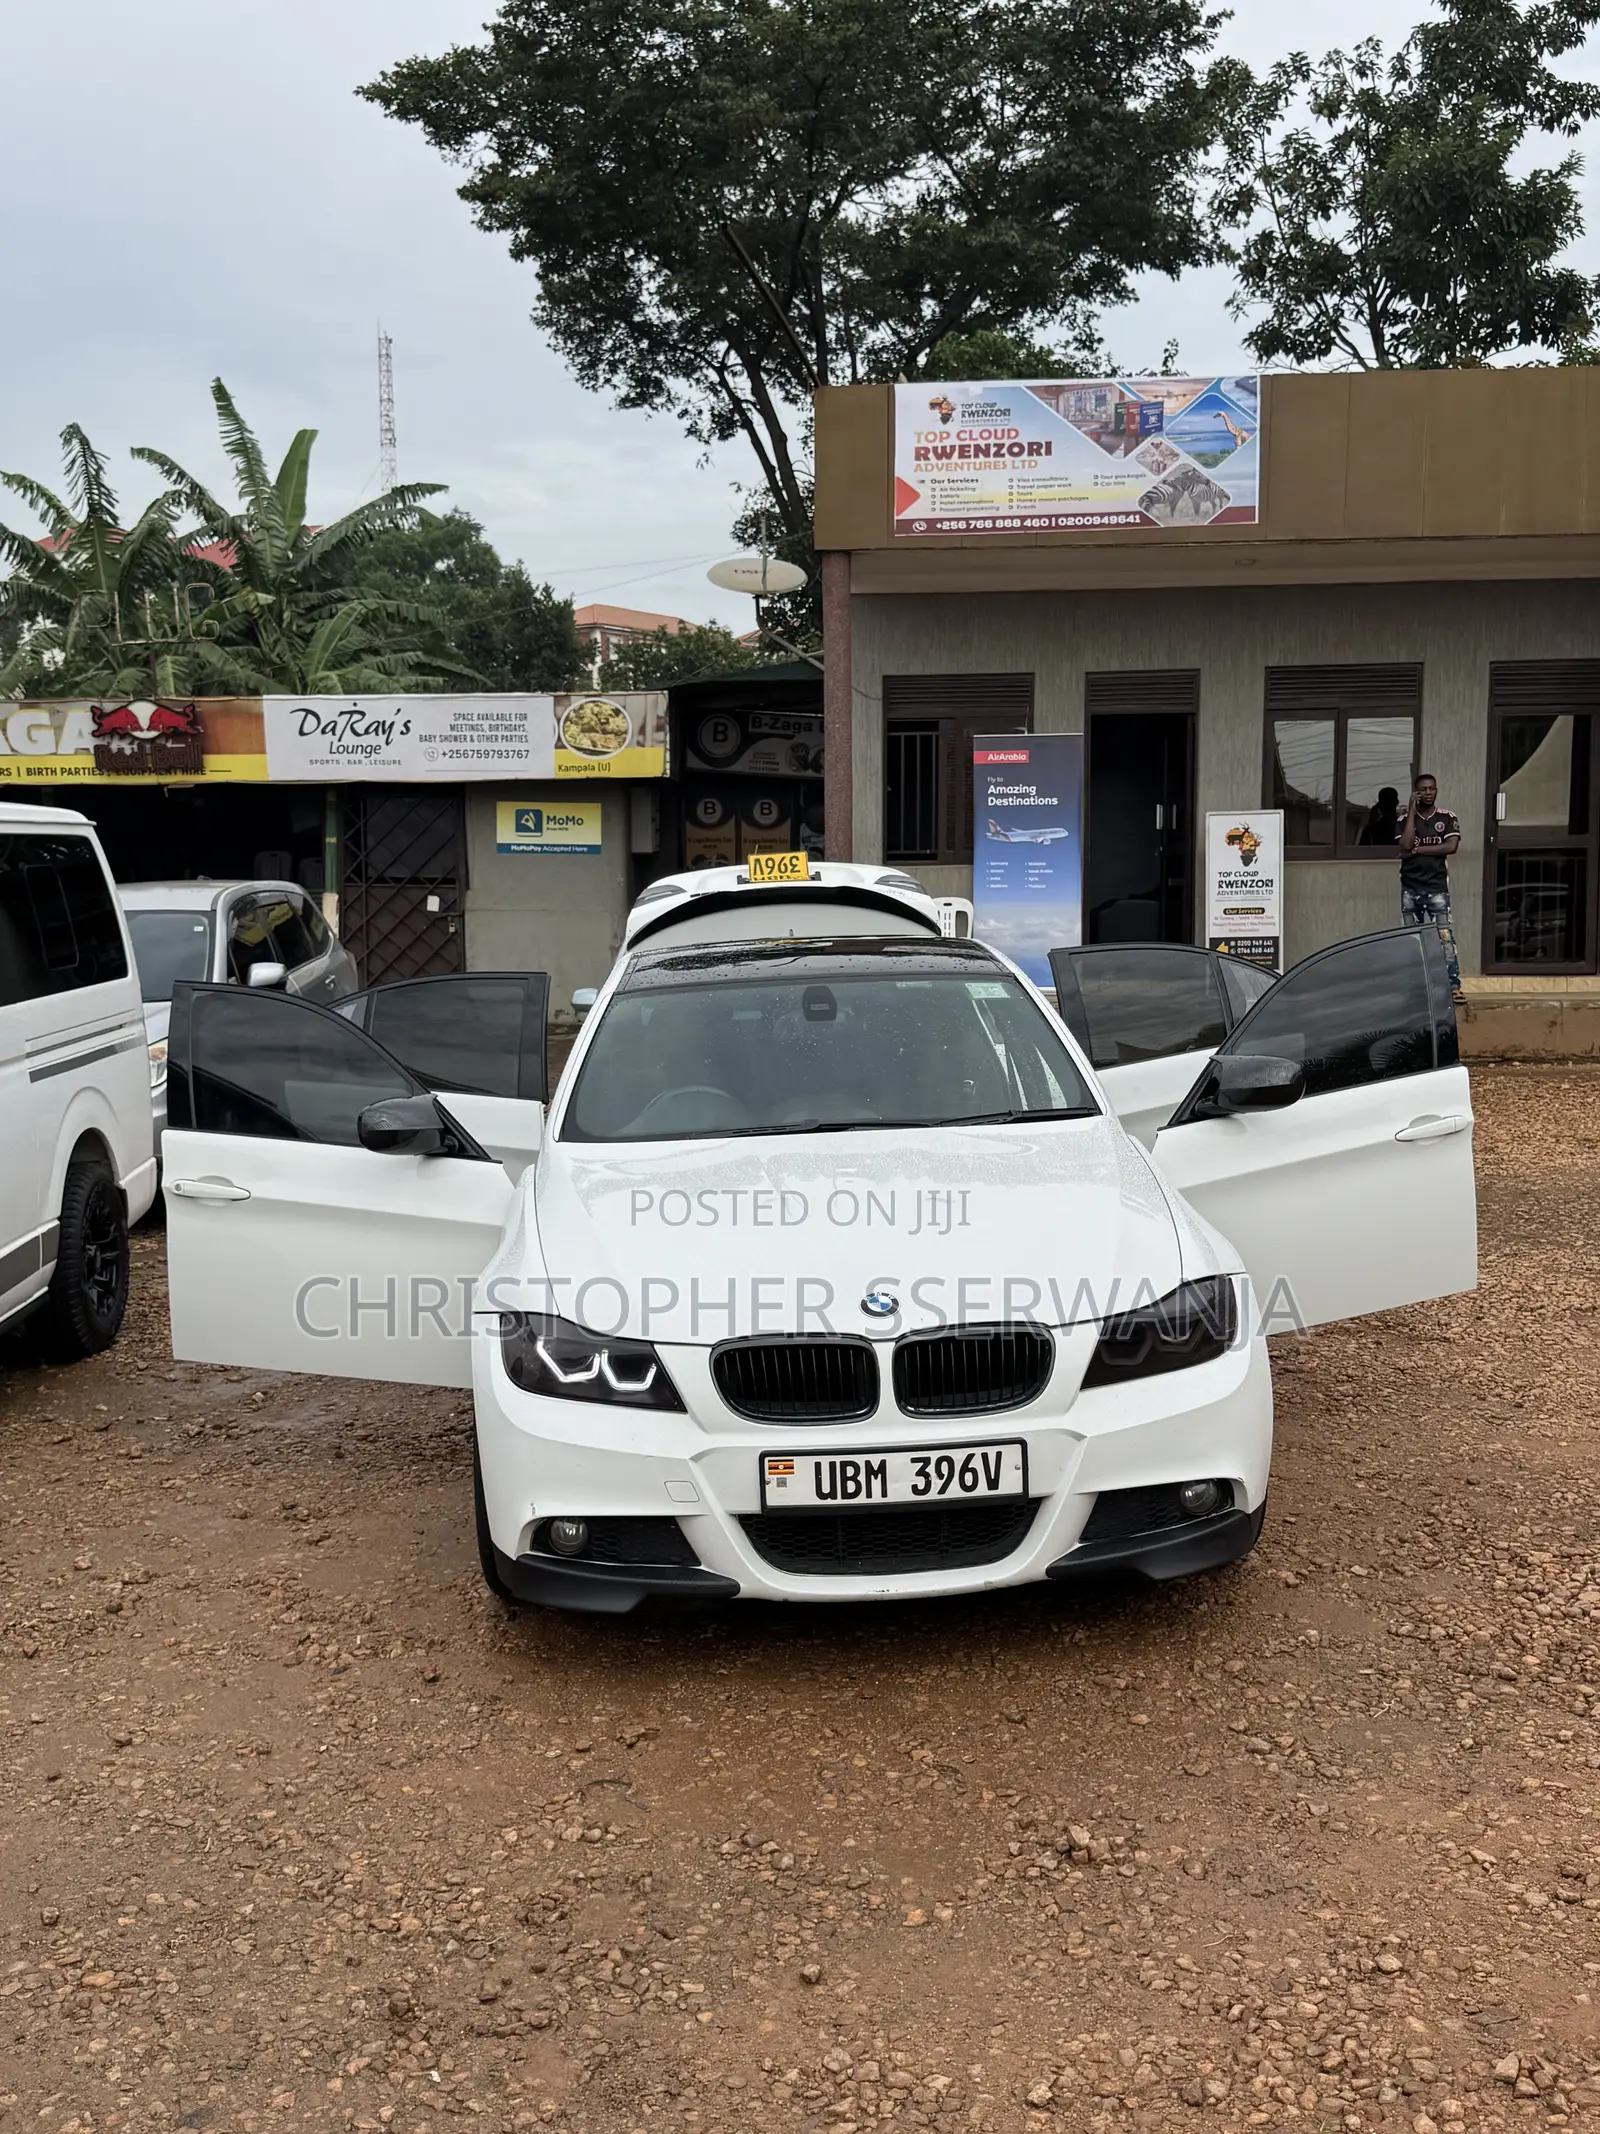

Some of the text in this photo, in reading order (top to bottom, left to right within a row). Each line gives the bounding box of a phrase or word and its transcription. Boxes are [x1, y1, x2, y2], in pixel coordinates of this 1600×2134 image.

[961, 408, 1011, 418] RWENZORI
[914, 428, 1019, 443] TOP CLOUD
[914, 441, 1052, 461] RWENZORI
[913, 459, 1038, 472] ADVENTURES LTD
[936, 520, 967, 530] +256
[969, 519, 993, 529] 766
[995, 518, 1021, 529] 868
[1023, 518, 1049, 528] 460
[1057, 515, 1141, 527] 0200949641
[453, 713, 528, 722] SPACE AVAILABLE FOR
[449, 723, 487, 733] MEETINGS,
[751, 716, 813, 733] B-Zaga
[0, 708, 95, 755] GA
[712, 721, 728, 743] B
[418, 734, 529, 743] BABY SHOWER & OTHER PARTIES
[329, 741, 382, 758] Lounge
[441, 749, 530, 759] +256759793767
[987, 752, 1027, 761] AirArabia
[26, 767, 58, 777] BIRTH
[60, 767, 105, 777] PARTIES
[557, 763, 596, 773] Kampala
[987, 776, 996, 784] Fly
[987, 784, 1037, 796] Amazing
[987, 795, 1059, 806] Destinations
[703, 801, 717, 815] B
[759, 801, 773, 816] B
[547, 815, 584, 826] MoMo
[510, 844, 542, 852] MoMoPay
[542, 845, 571, 853] Accepted
[1233, 870, 1259, 878] CLOUD
[1217, 879, 1274, 889] RWENZORI
[813, 1451, 1003, 1500] UBM 396V
